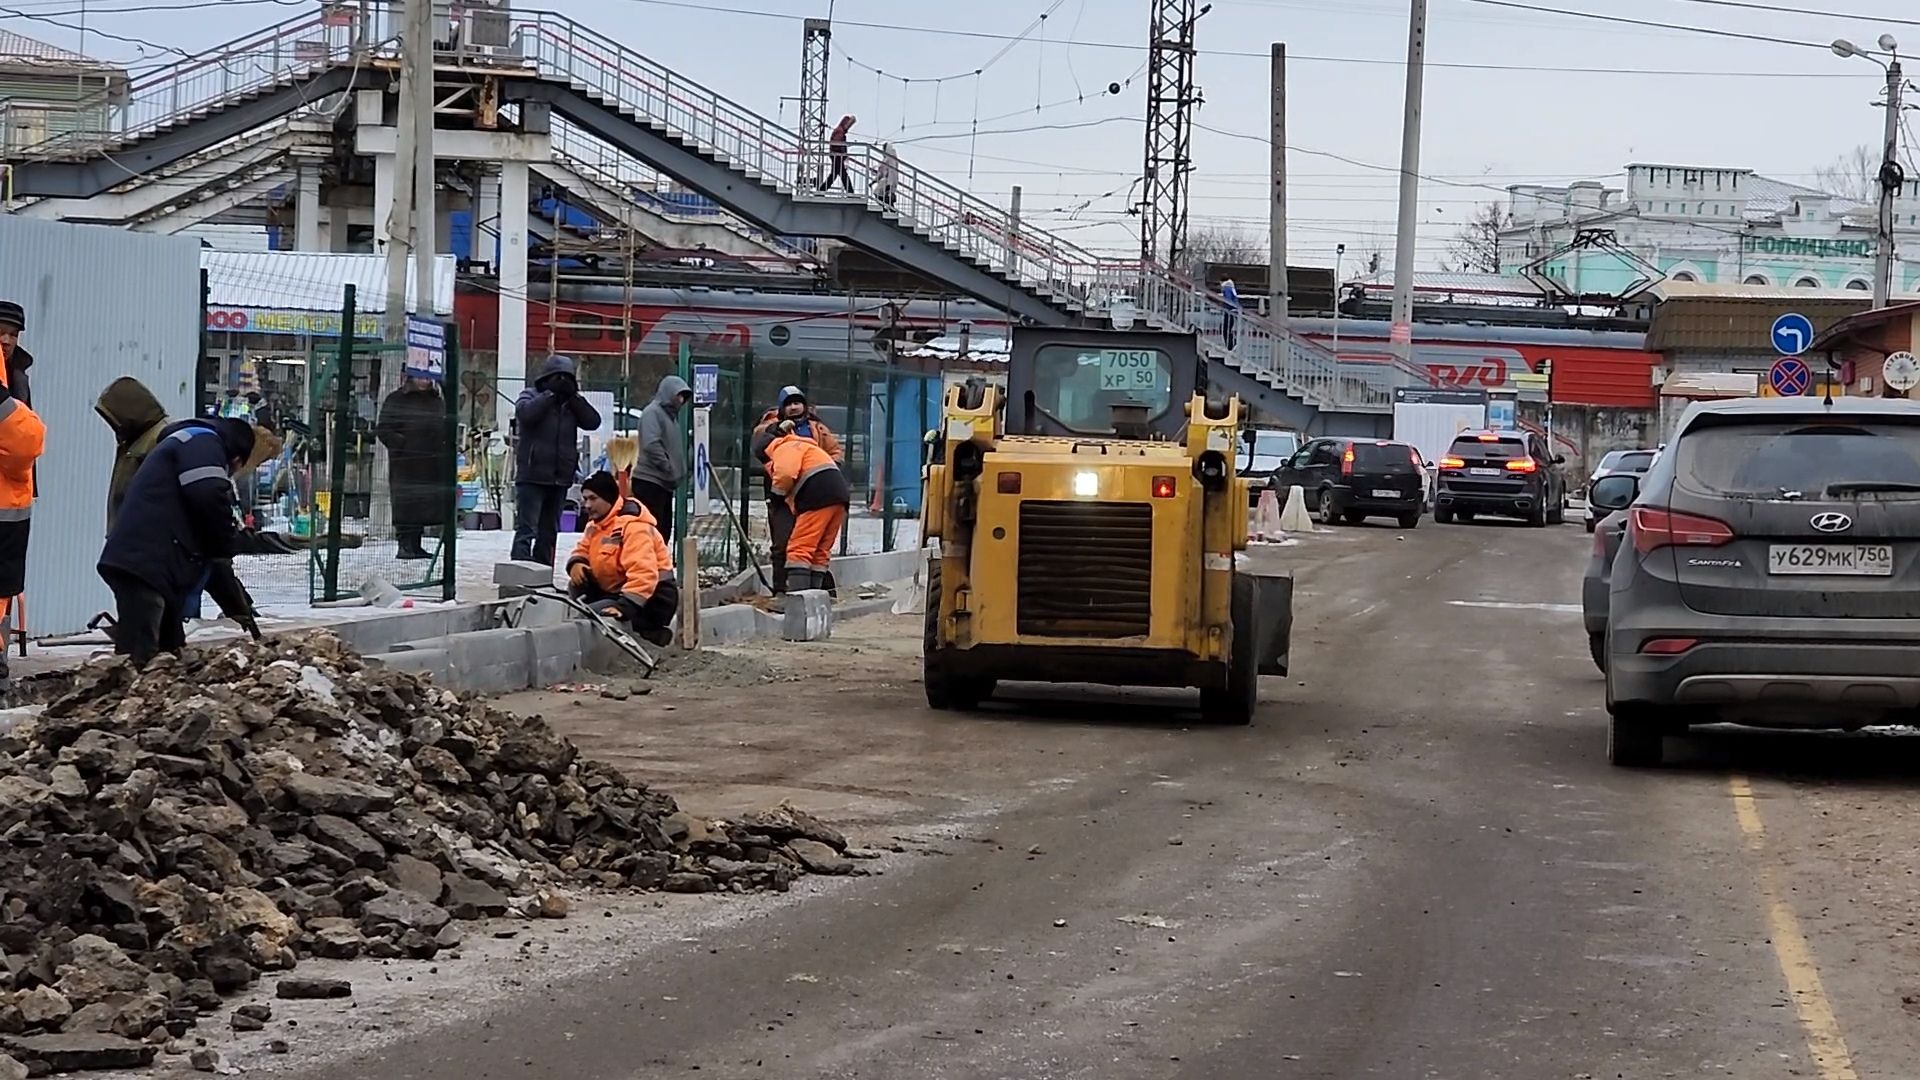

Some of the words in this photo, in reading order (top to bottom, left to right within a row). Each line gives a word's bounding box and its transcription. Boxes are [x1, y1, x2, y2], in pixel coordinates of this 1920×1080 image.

[254, 312, 378, 335] МЕЛОЧЙ
[1107, 352, 1150, 368] 7050
[1136, 371, 1153, 383] 50
[1857, 547, 1888, 562] 750
